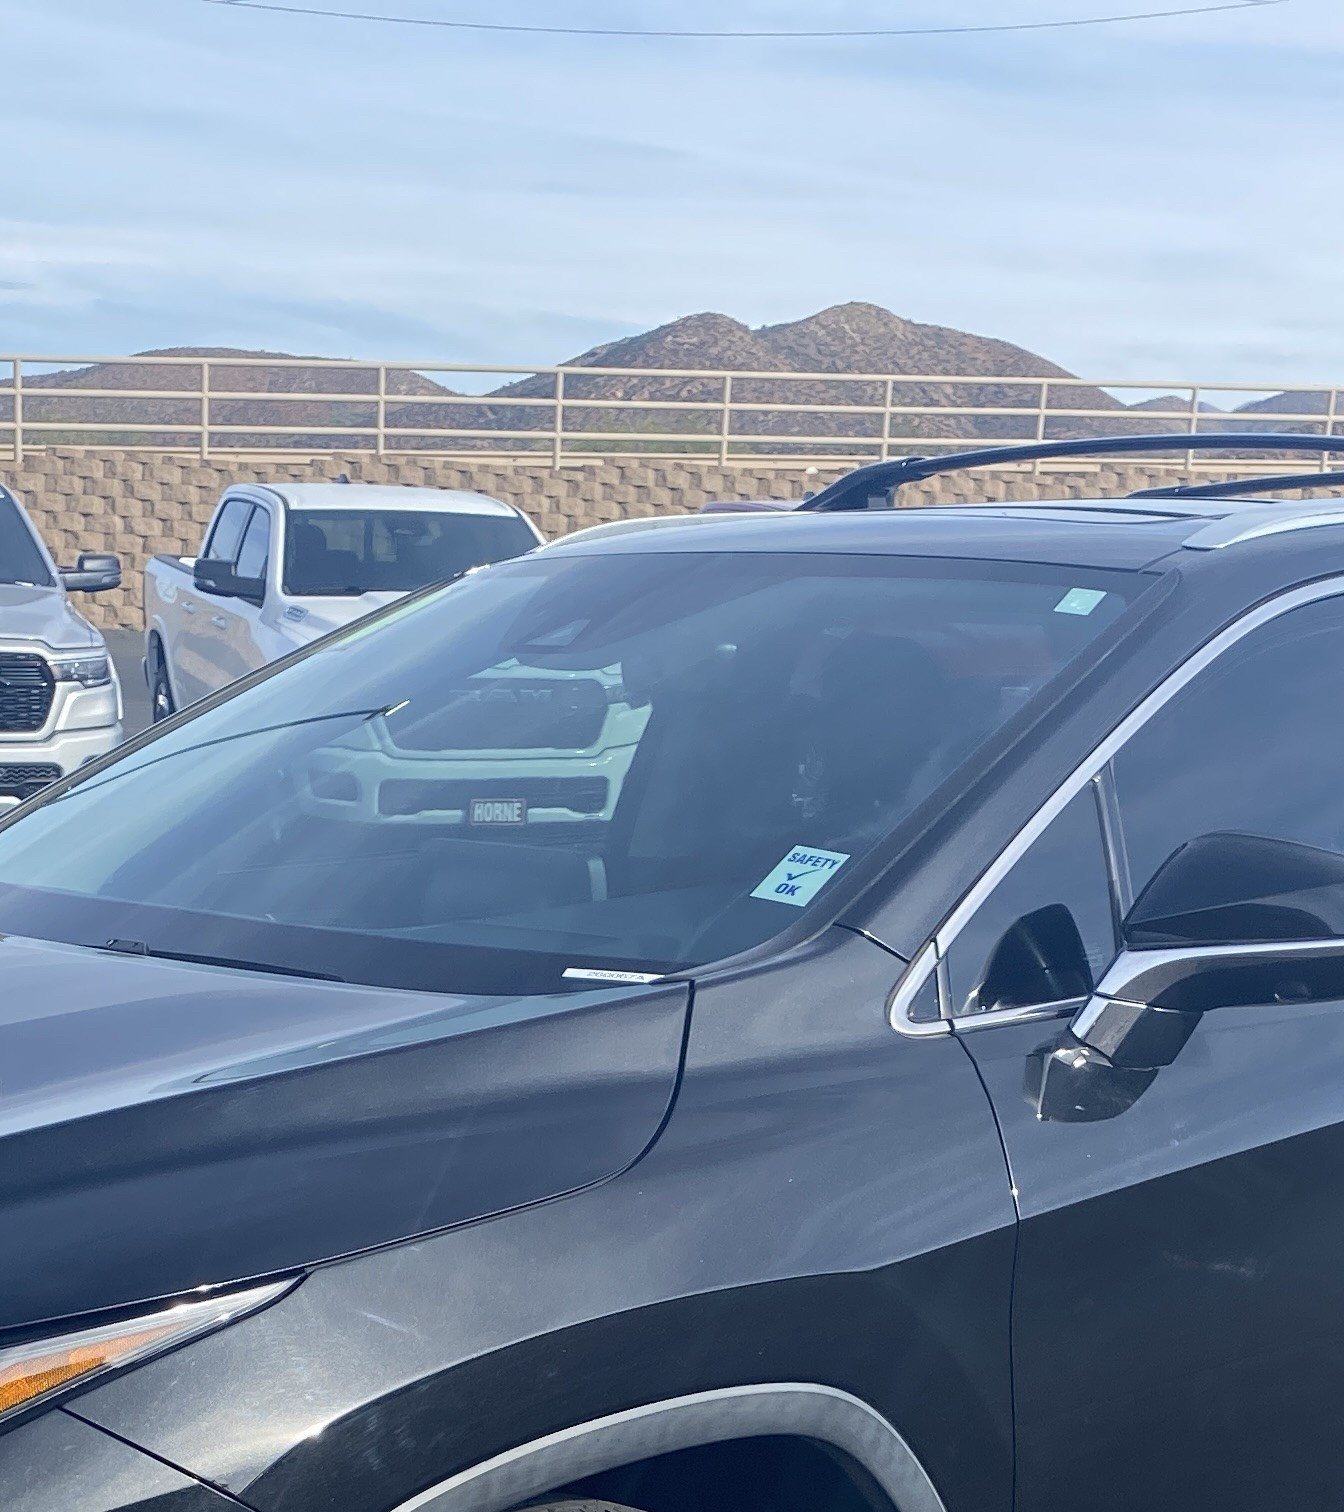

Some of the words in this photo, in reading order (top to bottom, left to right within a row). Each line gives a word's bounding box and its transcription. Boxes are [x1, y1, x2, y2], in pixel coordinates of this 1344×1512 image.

[474, 802, 522, 821] HORNE
[787, 852, 841, 870] SAFETY
[774, 883, 802, 897] OK
